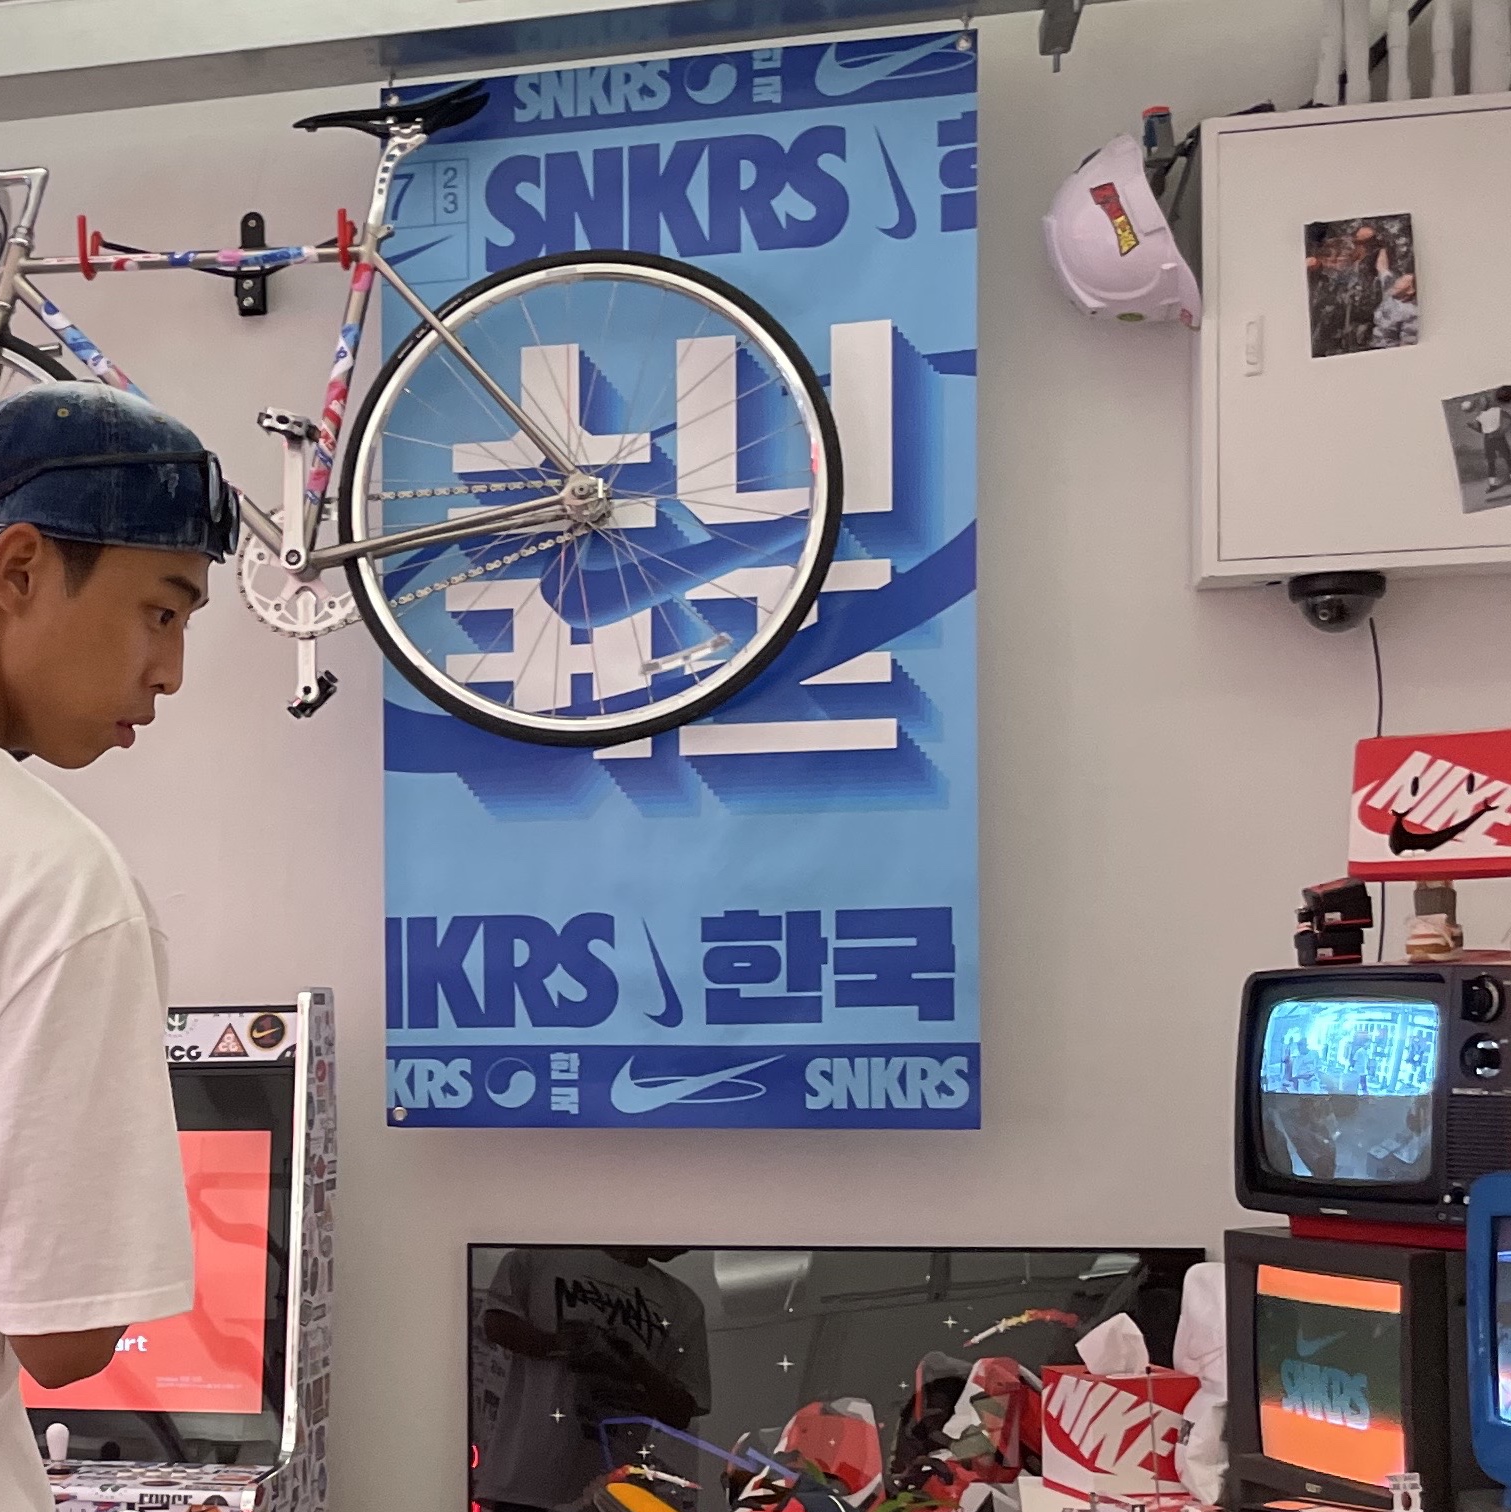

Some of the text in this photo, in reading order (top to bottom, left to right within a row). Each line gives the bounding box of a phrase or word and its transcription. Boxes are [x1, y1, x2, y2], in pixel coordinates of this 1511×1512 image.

[514, 60, 671, 123] SNKRS
[486, 125, 849, 272] SNKRS
[701, 907, 956, 1025] 한국
[804, 1056, 970, 1110] SNKRS
[1047, 1374, 1185, 1479] NIKE
